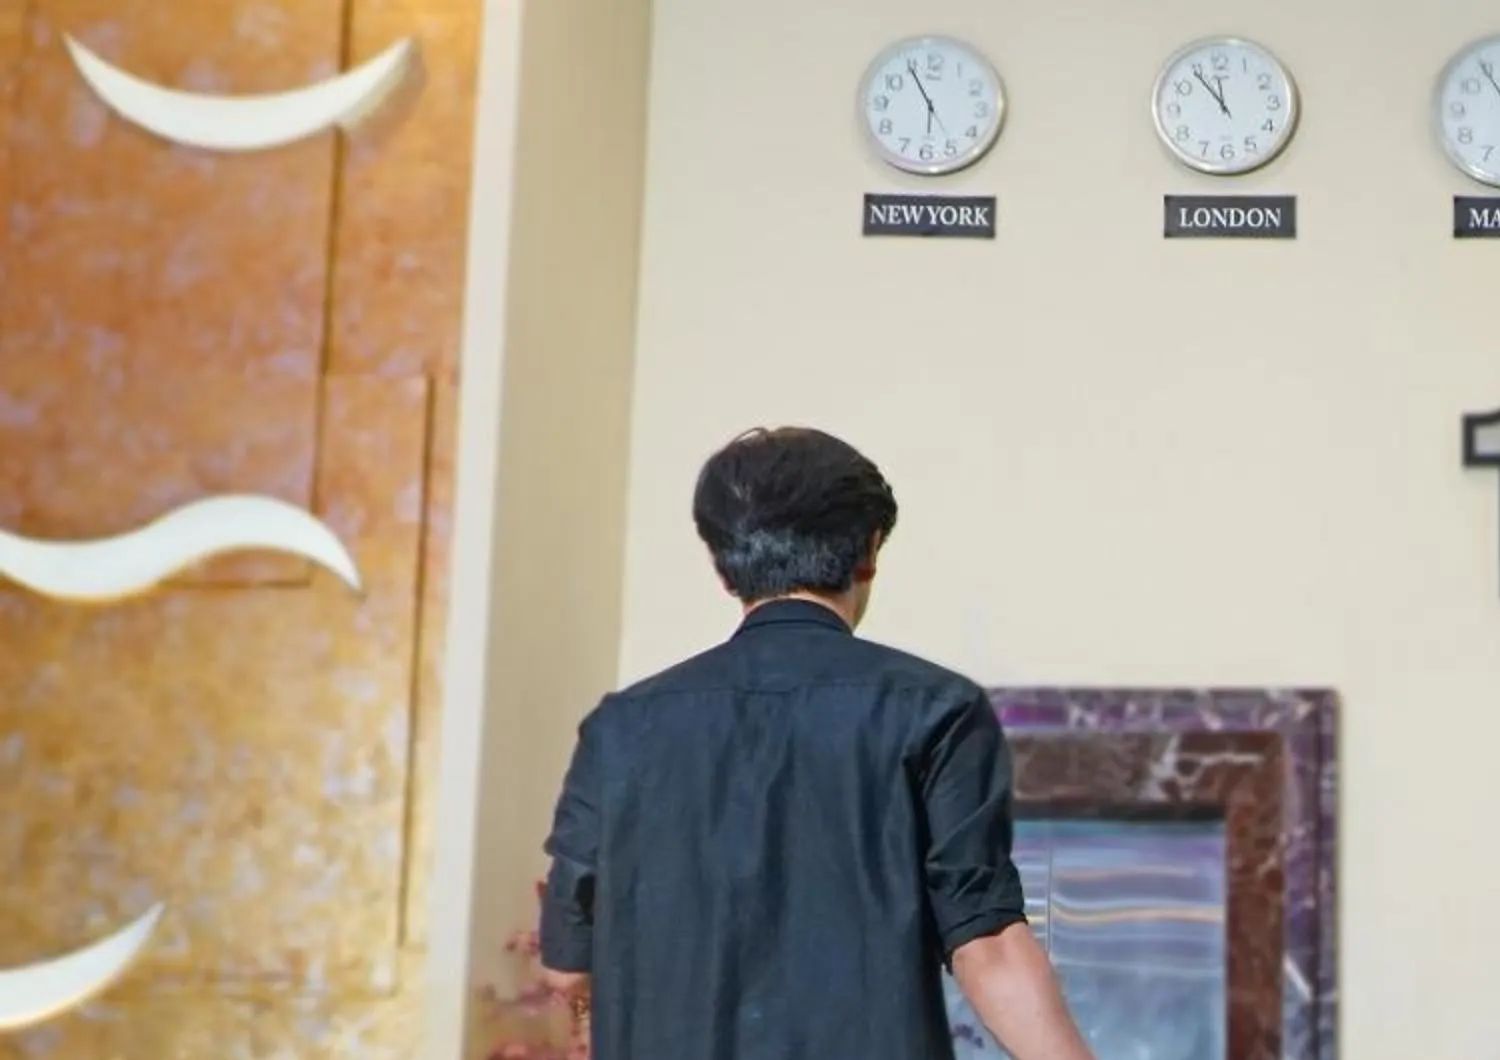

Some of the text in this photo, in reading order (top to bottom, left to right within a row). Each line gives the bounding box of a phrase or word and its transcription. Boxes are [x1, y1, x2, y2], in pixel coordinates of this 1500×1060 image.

[884, 73, 903, 91] 10
[1173, 78, 1193, 97] 10
[1257, 72, 1271, 91] 2
[1460, 78, 1481, 96] 10
[1167, 102, 1182, 118] 9
[1266, 94, 1281, 112] 3
[1450, 101, 1466, 119] 9
[879, 117, 893, 135] 8
[964, 125, 978, 138] 4
[1175, 125, 1190, 141] 8
[1260, 118, 1274, 132] 4
[1243, 135, 1257, 153] 5
[1457, 127, 1473, 145] 8
[898, 137, 912, 154] 7
[919, 143, 934, 160] 6
[943, 139, 957, 157] 5
[1197, 140, 1210, 157] 7
[1220, 143, 1235, 161] 6
[1480, 145, 1495, 163] 7
[870, 205, 990, 226] NEW YORK
[1179, 207, 1281, 228] LONDON
